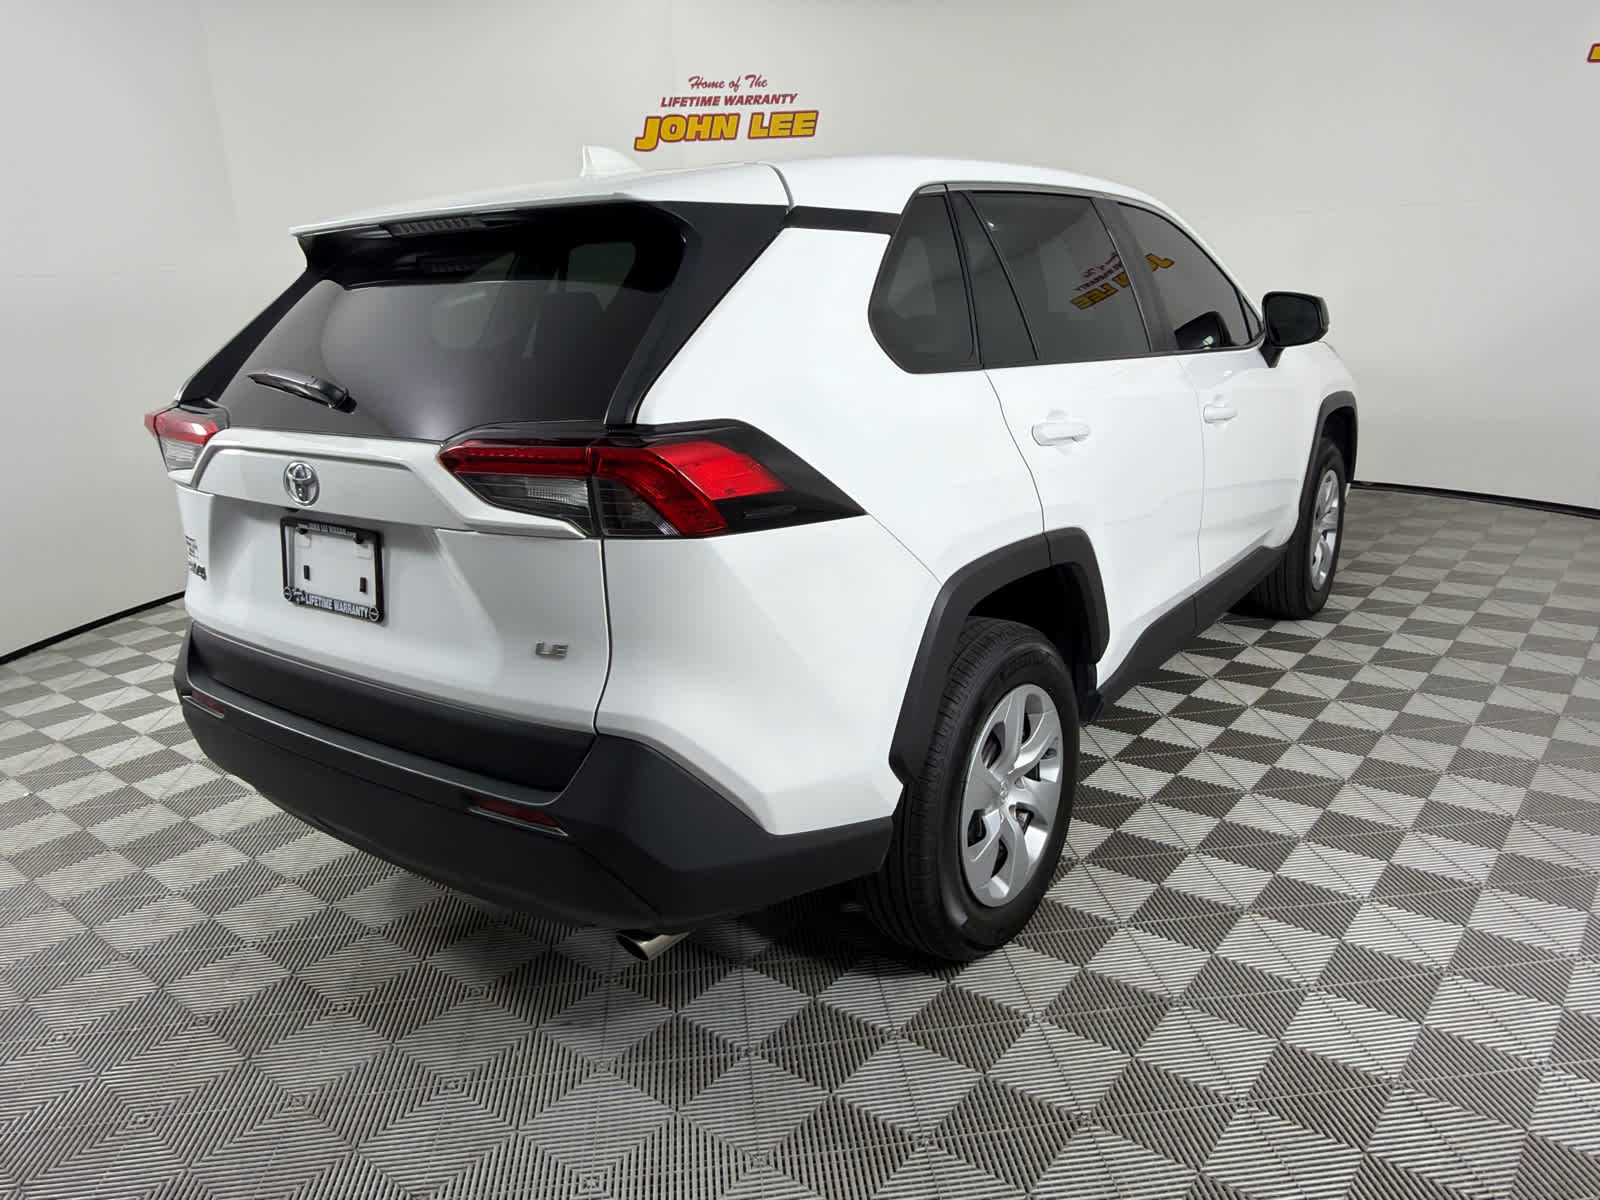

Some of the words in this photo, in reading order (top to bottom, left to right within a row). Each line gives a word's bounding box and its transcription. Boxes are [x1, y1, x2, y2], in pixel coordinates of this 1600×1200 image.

[688, 75, 725, 90] Home
[728, 75, 742, 93] of
[744, 74, 768, 89] The
[660, 95, 721, 108] LIFETIME
[724, 93, 798, 106] WARRANTY
[634, 112, 741, 152] JOHN
[747, 109, 819, 140] LEE
[305, 593, 333, 610] LIFETIME
[333, 600, 369, 618] WARRANTY
[535, 642, 569, 659] LE
